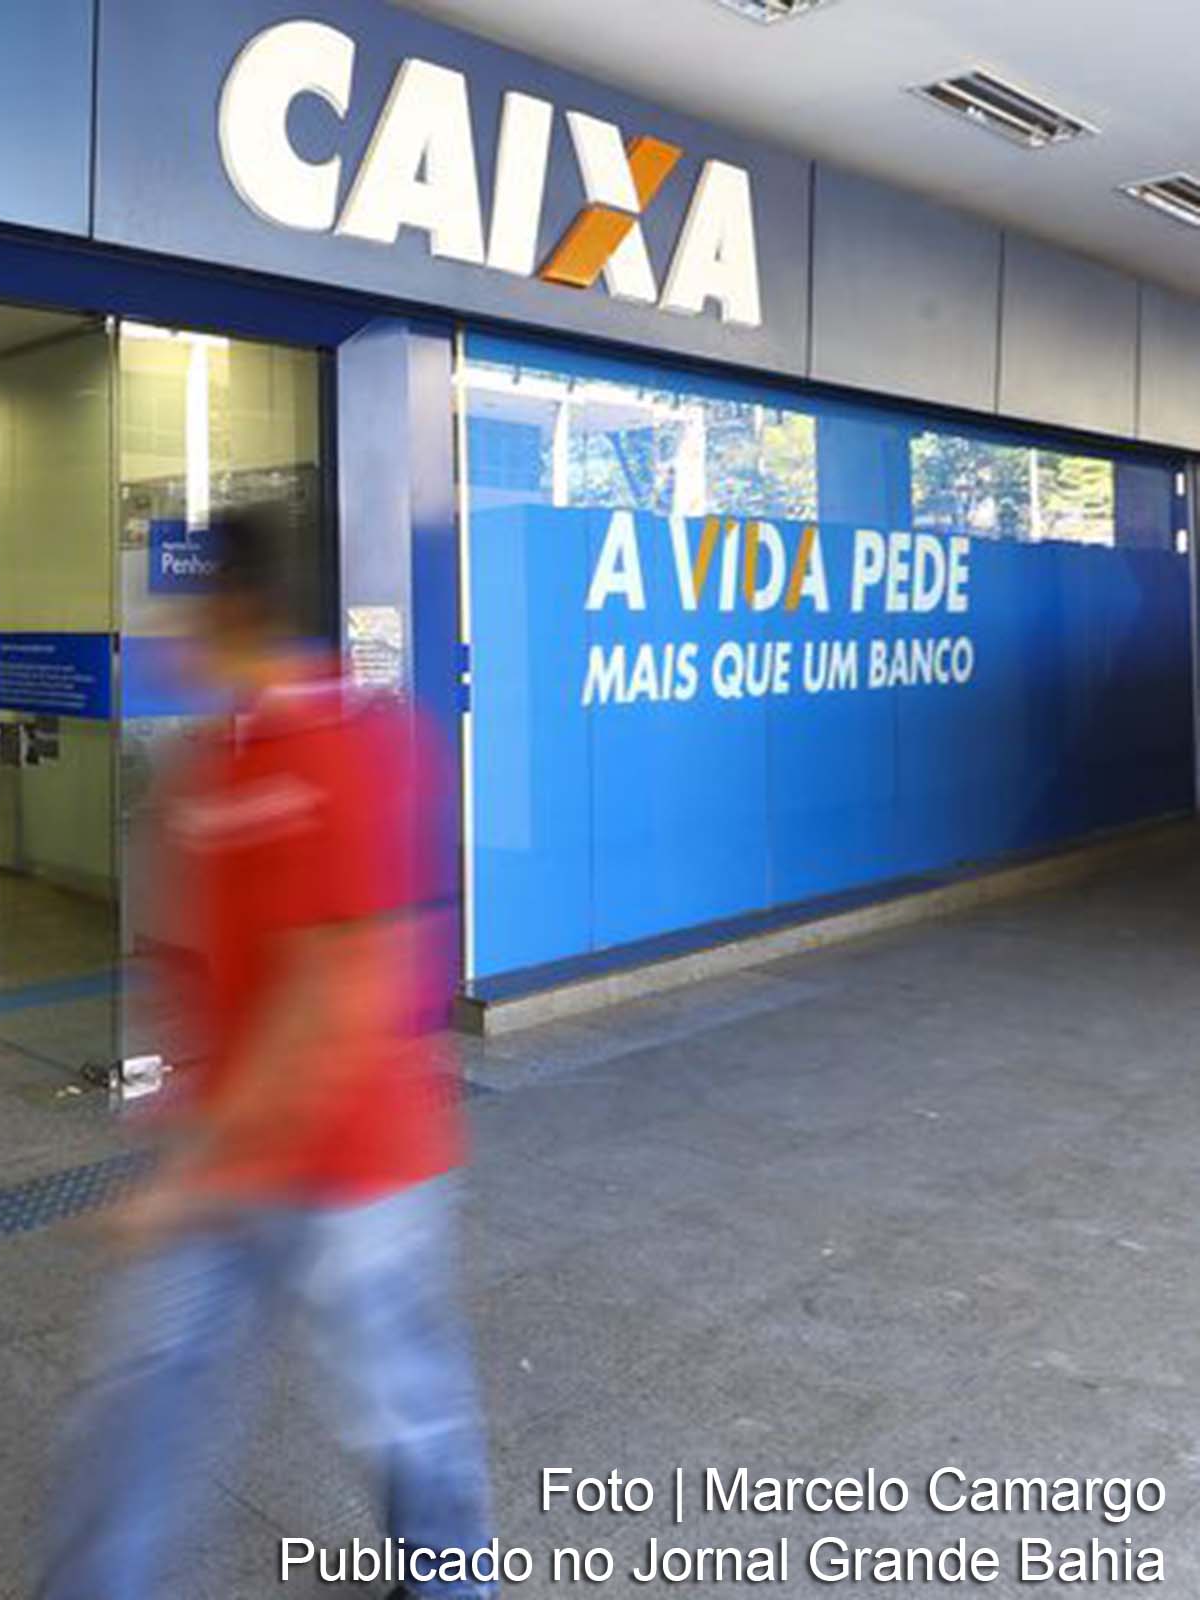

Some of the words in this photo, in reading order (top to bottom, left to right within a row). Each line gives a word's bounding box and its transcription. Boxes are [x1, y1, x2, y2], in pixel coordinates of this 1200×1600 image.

[218, 20, 761, 326] CAIXA
[585, 511, 645, 611] A
[669, 513, 829, 612] VIDA
[851, 530, 970, 613] PEDE
[582, 643, 697, 706] MAIS
[712, 641, 790, 699] QUE
[802, 638, 857, 692] UM
[868, 636, 973, 688] BANCO
